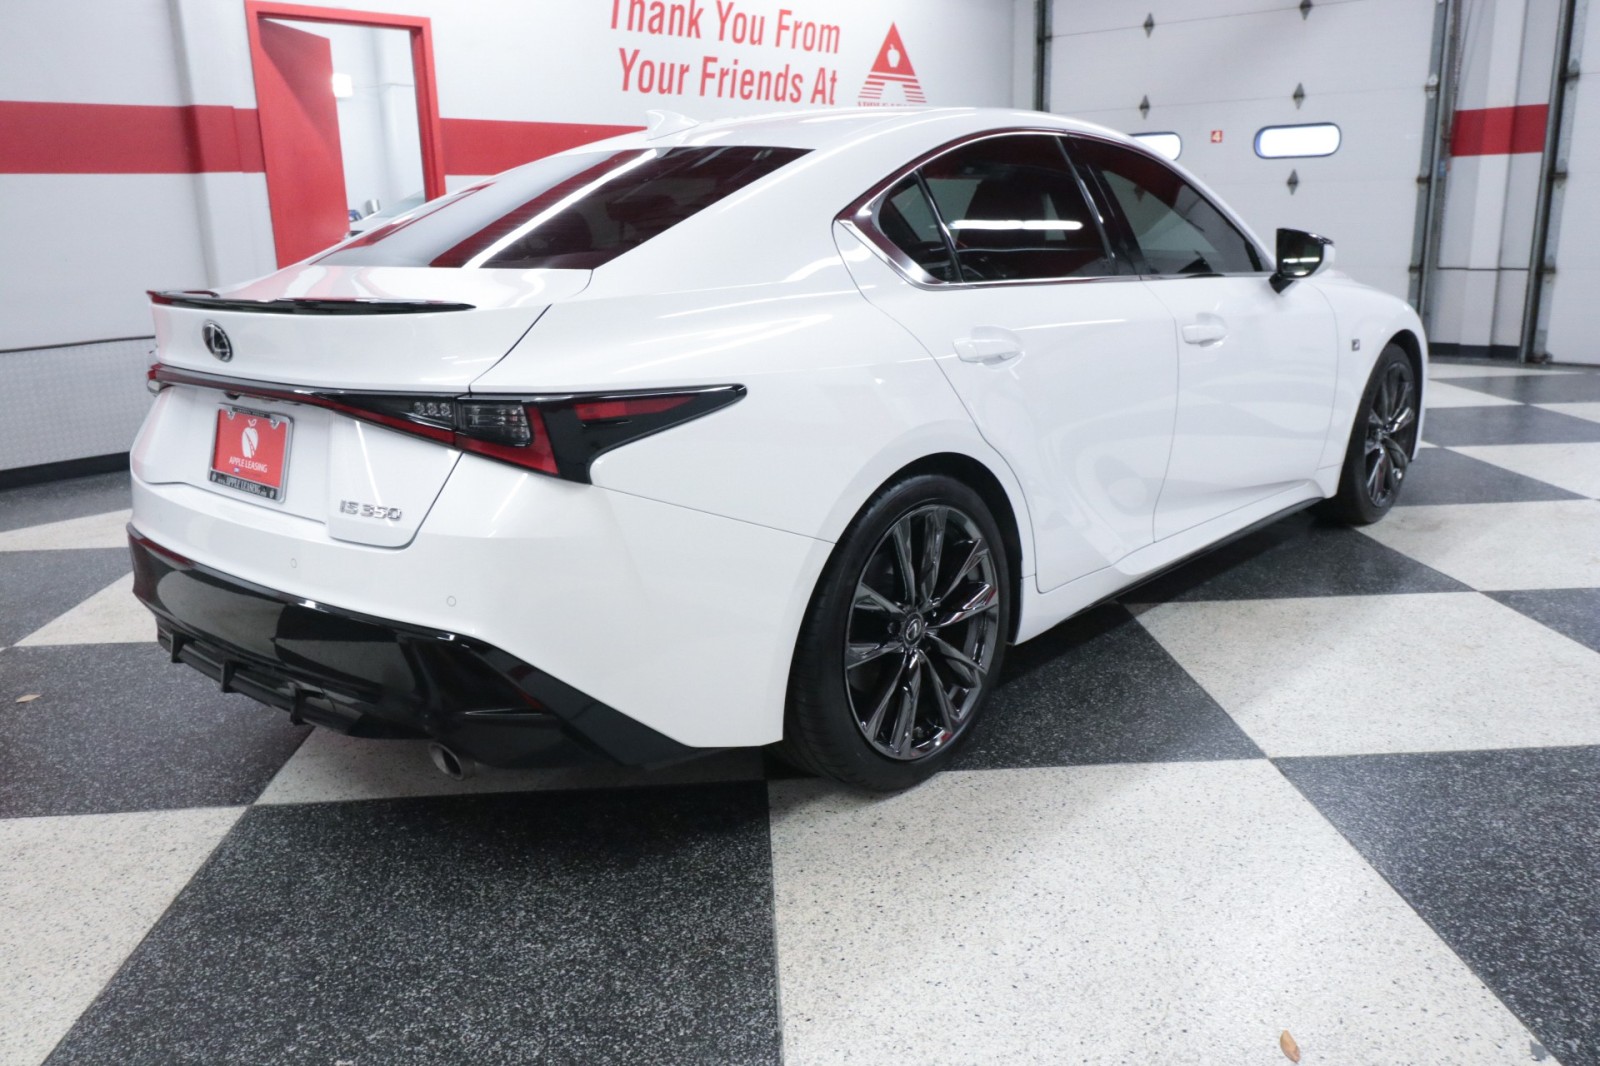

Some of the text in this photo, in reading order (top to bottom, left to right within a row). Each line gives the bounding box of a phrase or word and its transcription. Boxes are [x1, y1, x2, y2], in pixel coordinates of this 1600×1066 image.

[611, 0, 840, 54] Thank You From
[619, 47, 837, 105] Your Friends At
[229, 456, 267, 473] APPLE LEASING
[340, 500, 402, 521] IS 350
